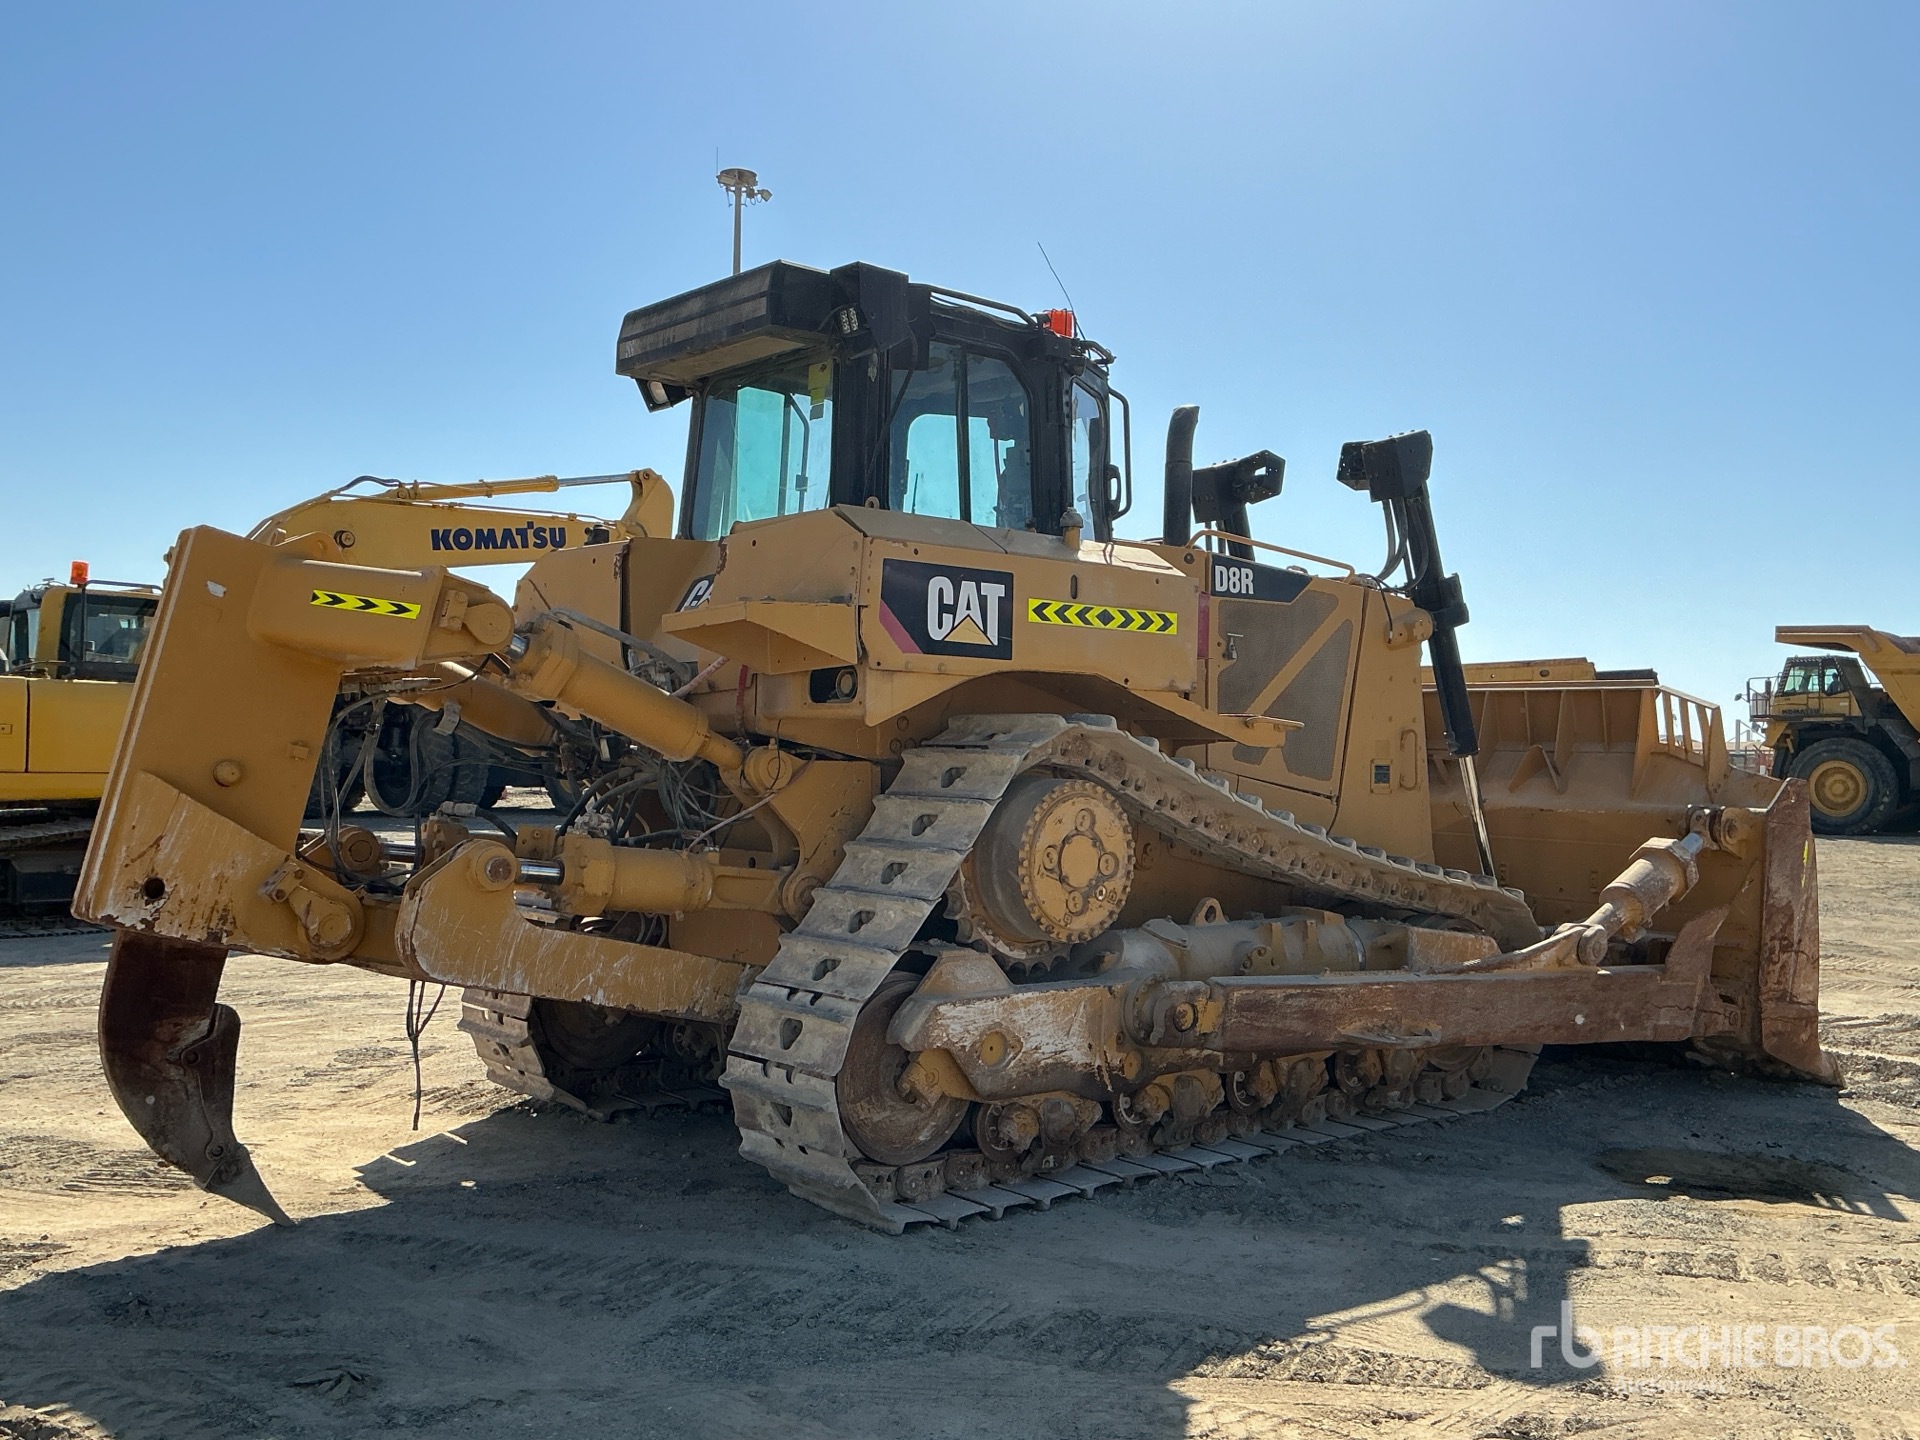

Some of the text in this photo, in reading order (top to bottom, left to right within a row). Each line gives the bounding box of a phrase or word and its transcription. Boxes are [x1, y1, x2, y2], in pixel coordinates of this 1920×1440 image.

[431, 521, 567, 551] KOMATSU
[1214, 565, 1254, 595] D8R
[927, 576, 1006, 646] CAT
